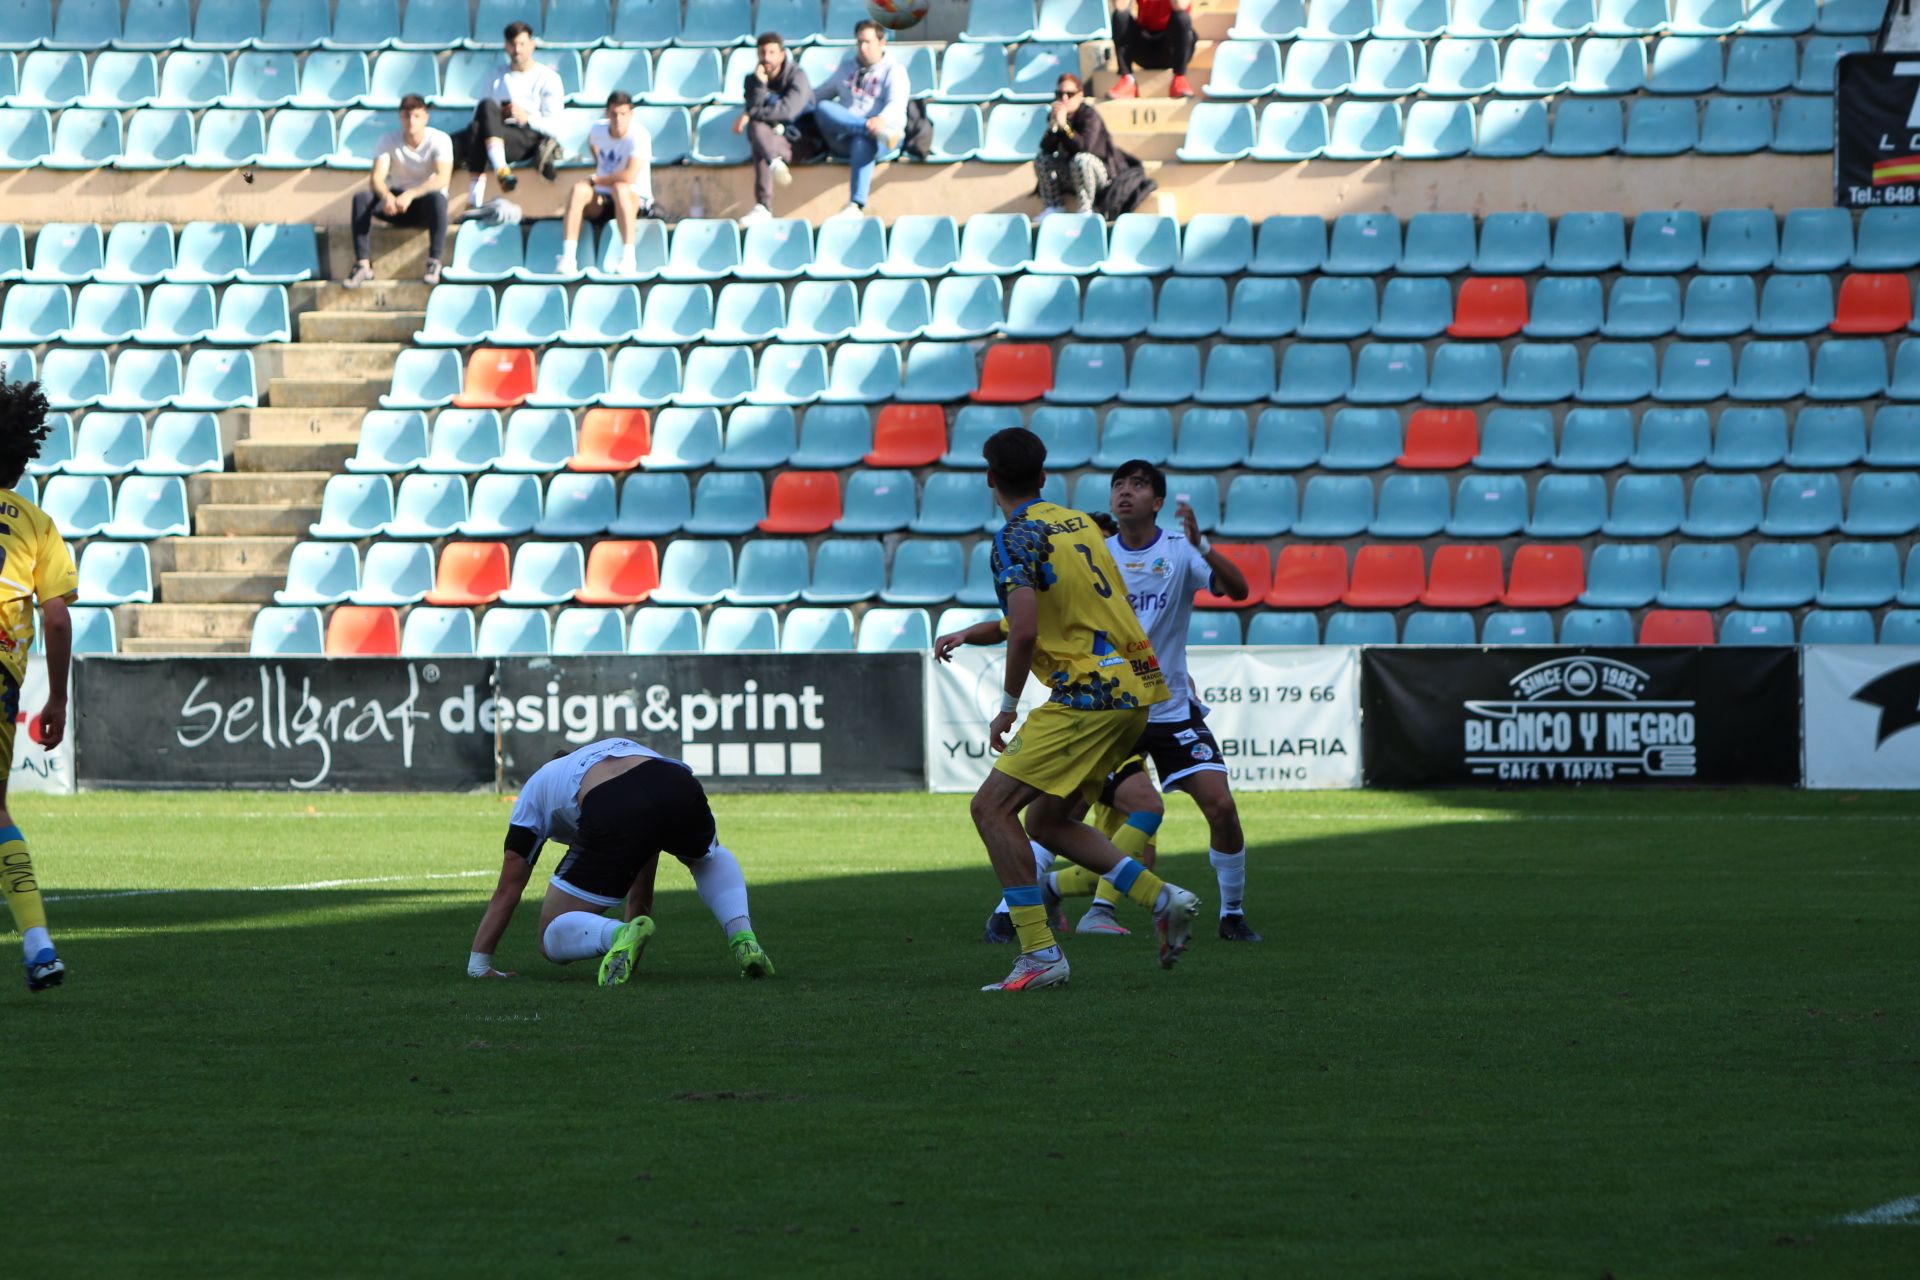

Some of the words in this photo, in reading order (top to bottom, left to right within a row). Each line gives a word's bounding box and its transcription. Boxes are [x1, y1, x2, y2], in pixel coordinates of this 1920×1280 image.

[1131, 109, 1156, 125] 10
[1884, 186, 1915, 204] 648
[1074, 543, 1113, 598] 3
[1126, 591, 1167, 610] eins
[1519, 667, 1563, 695] SINCE
[1602, 667, 1638, 691] 1983
[1204, 686, 1242, 703] 638
[1249, 687, 1269, 703] 91
[1276, 686, 1302, 702] 79
[1310, 686, 1335, 702] 66
[177, 662, 430, 788] Sellgraf
[439, 679, 824, 743] design&print
[1465, 712, 1572, 751] BLANCO
[1579, 712, 1598, 751] Y
[1606, 712, 1695, 751] NEGRO
[1222, 739, 1347, 756] BILIARIA
[1230, 767, 1307, 780] ULTING
[1545, 762, 1556, 780] Y
[1562, 762, 1614, 780] TAPAS
